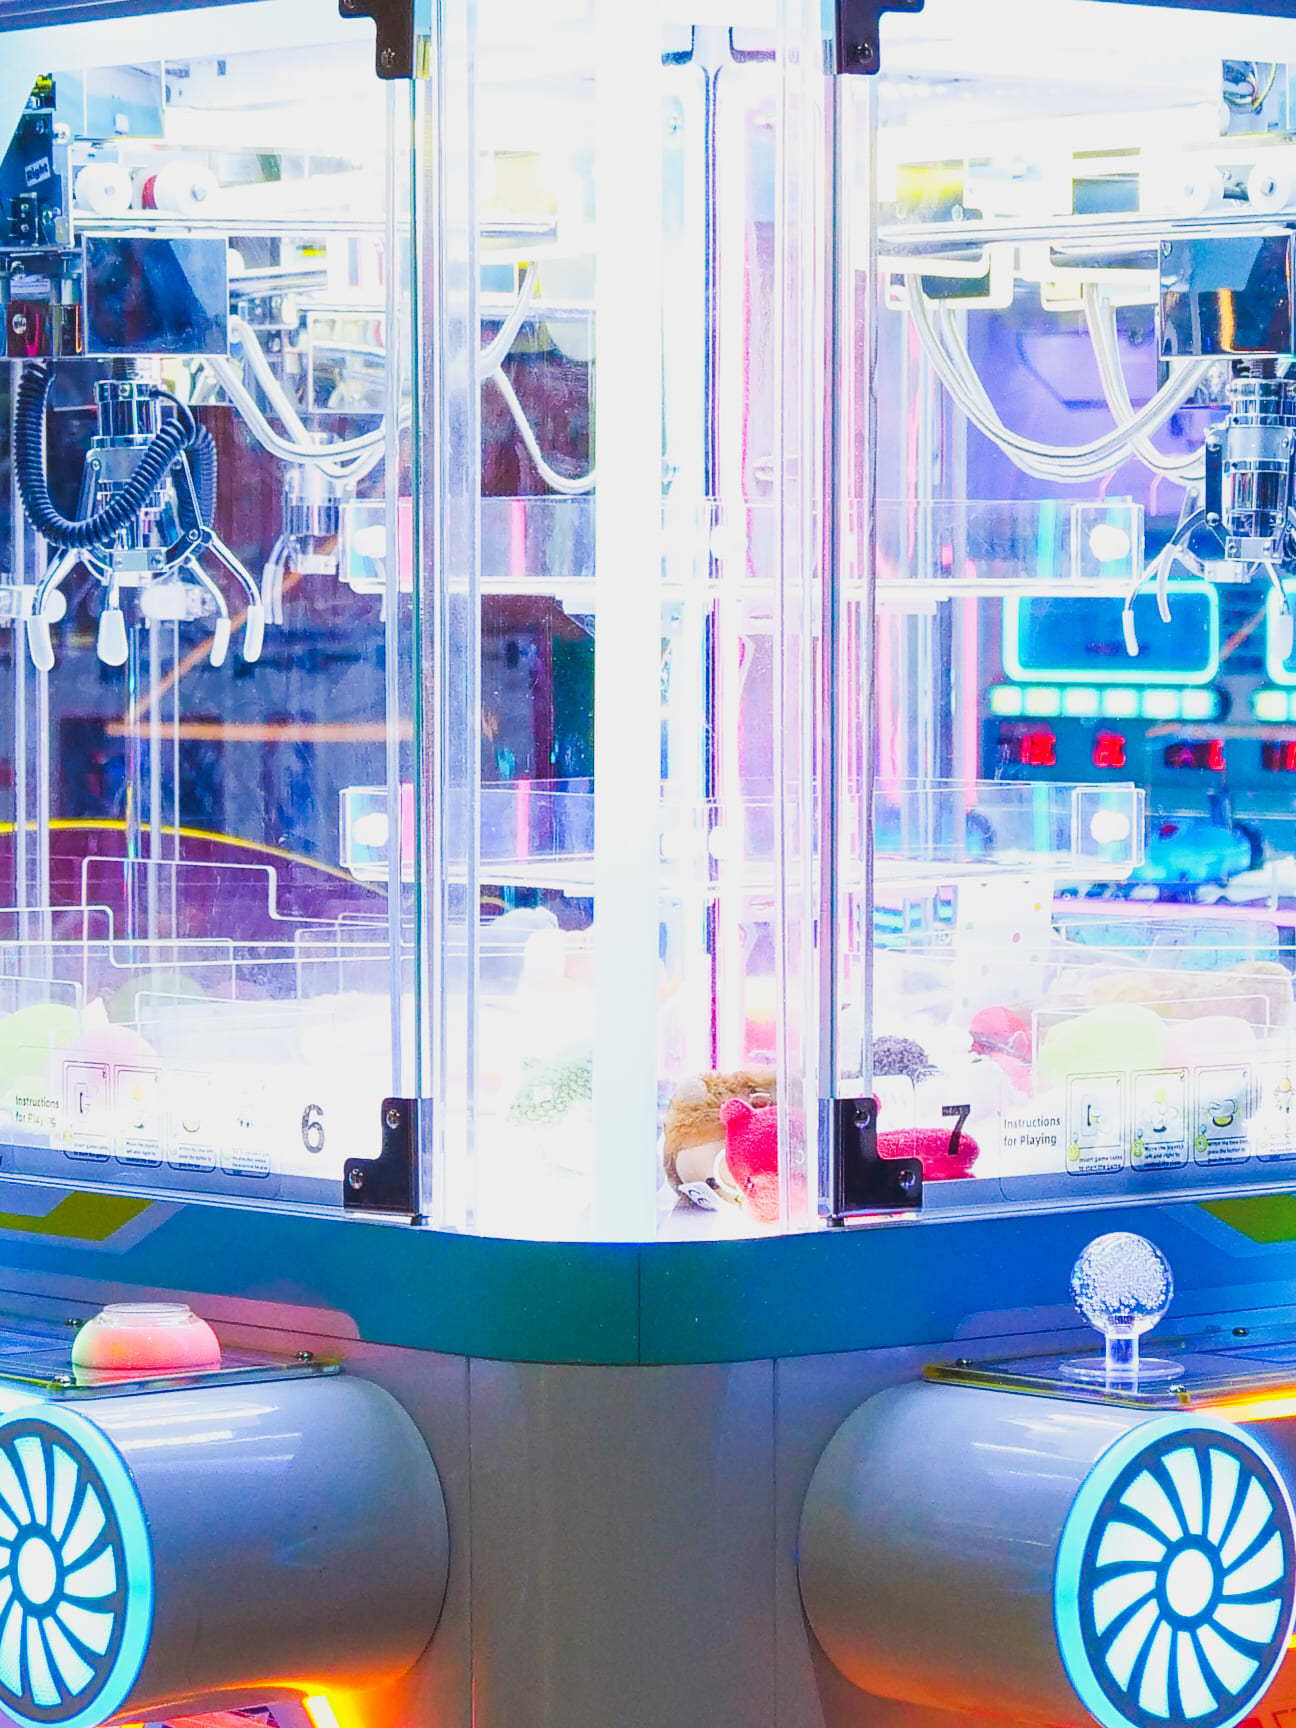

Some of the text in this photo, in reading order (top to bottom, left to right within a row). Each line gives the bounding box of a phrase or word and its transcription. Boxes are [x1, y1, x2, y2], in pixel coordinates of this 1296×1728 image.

[16, 1096, 59, 1110] Instructions
[301, 1103, 325, 1154] 6
[1004, 1115, 1061, 1129] Instructions
[941, 1104, 971, 1155] 7
[1004, 1134, 1057, 1148] for Playing
